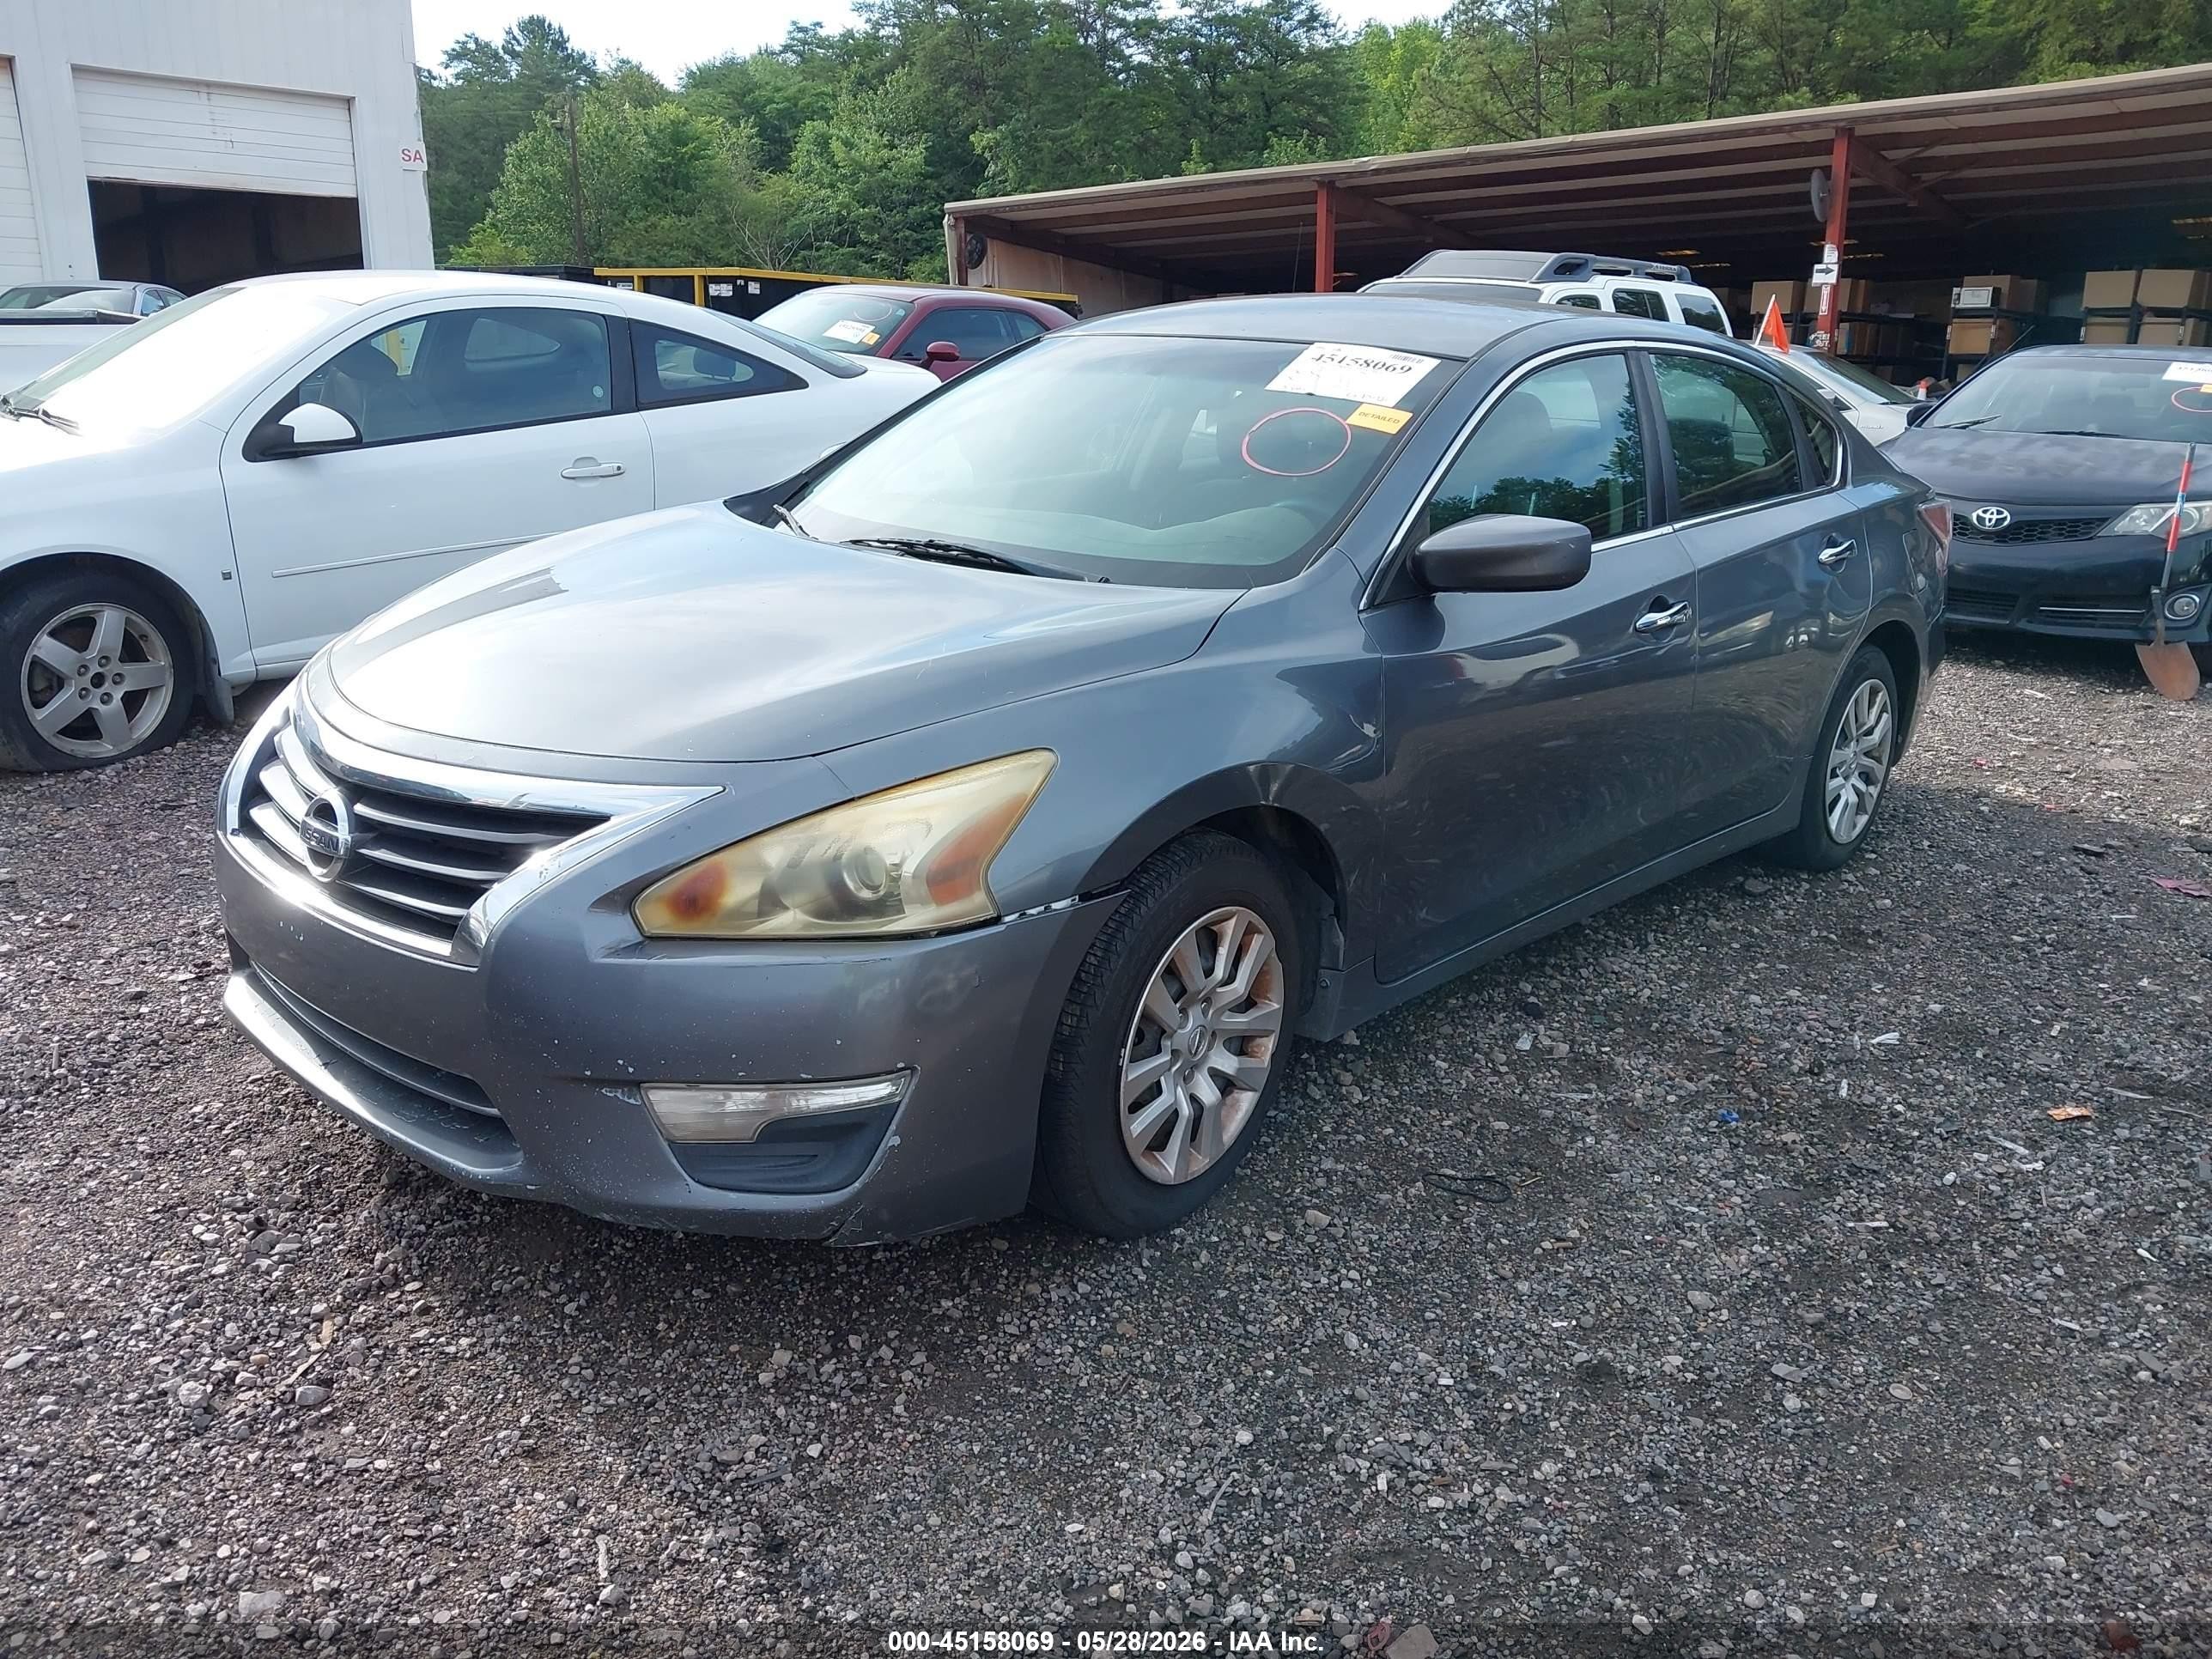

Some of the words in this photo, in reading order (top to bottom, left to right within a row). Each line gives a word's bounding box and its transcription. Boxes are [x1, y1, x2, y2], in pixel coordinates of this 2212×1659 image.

[401, 148, 424, 163] SA
[1311, 354, 1413, 374] 45158069
[1358, 411, 1401, 424] DETAILED
